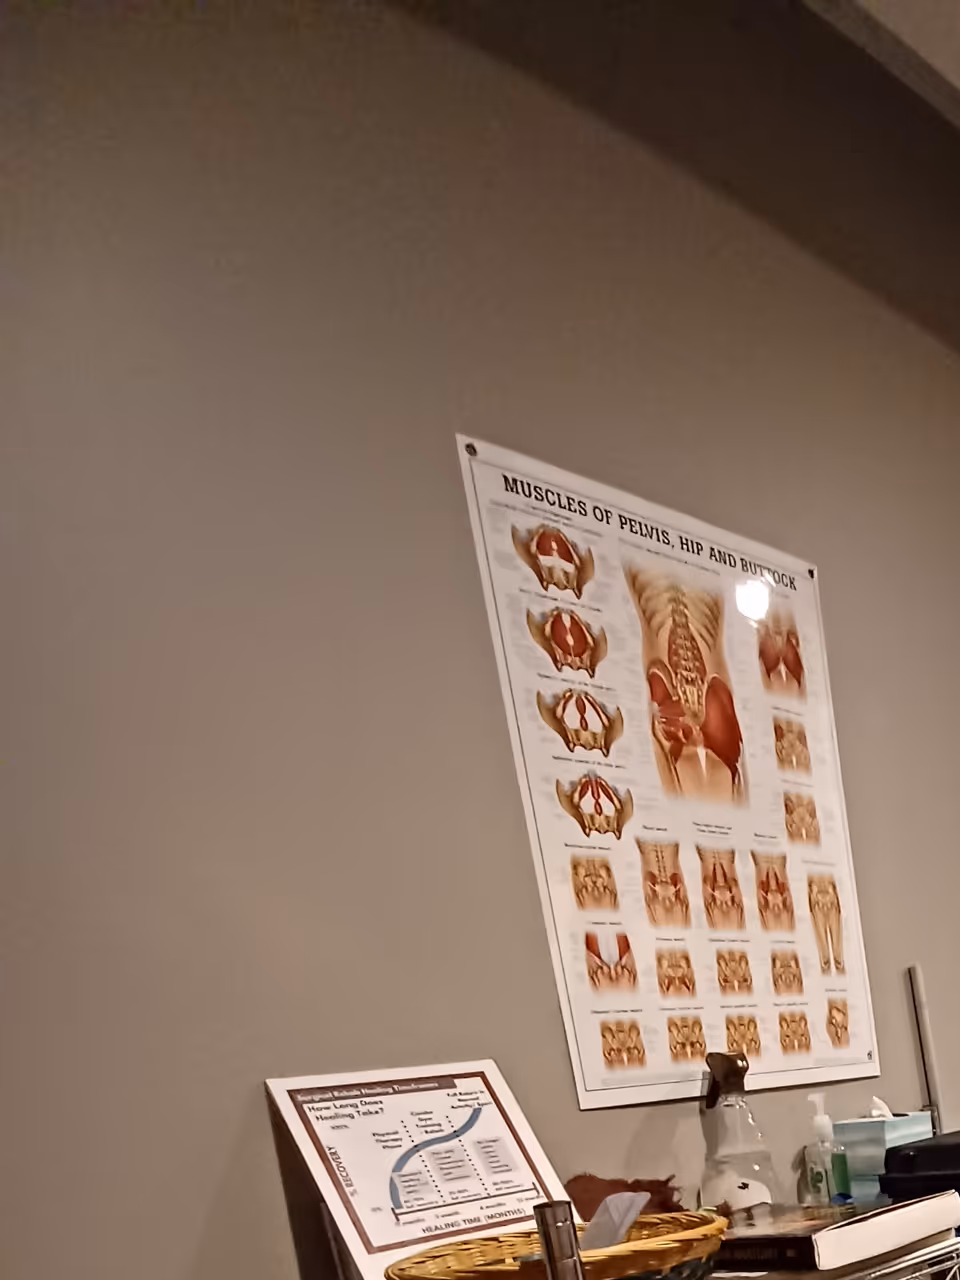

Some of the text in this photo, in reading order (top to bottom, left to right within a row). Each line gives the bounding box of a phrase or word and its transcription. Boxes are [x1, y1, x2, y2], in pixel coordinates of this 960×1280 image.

[502, 473, 588, 517] MUSCLES
[592, 506, 613, 525] OF
[618, 513, 675, 549] PELVIS,
[679, 535, 704, 556] HIP
[709, 547, 737, 568] AND
[740, 557, 798, 591] BUTTOCK
[307, 1099, 383, 1113] How Long Does
[315, 1107, 385, 1122] Healing Take?
[326, 1145, 355, 1189] RECOVERY
[421, 1220, 461, 1235] HEALING
[462, 1216, 483, 1227] TIME
